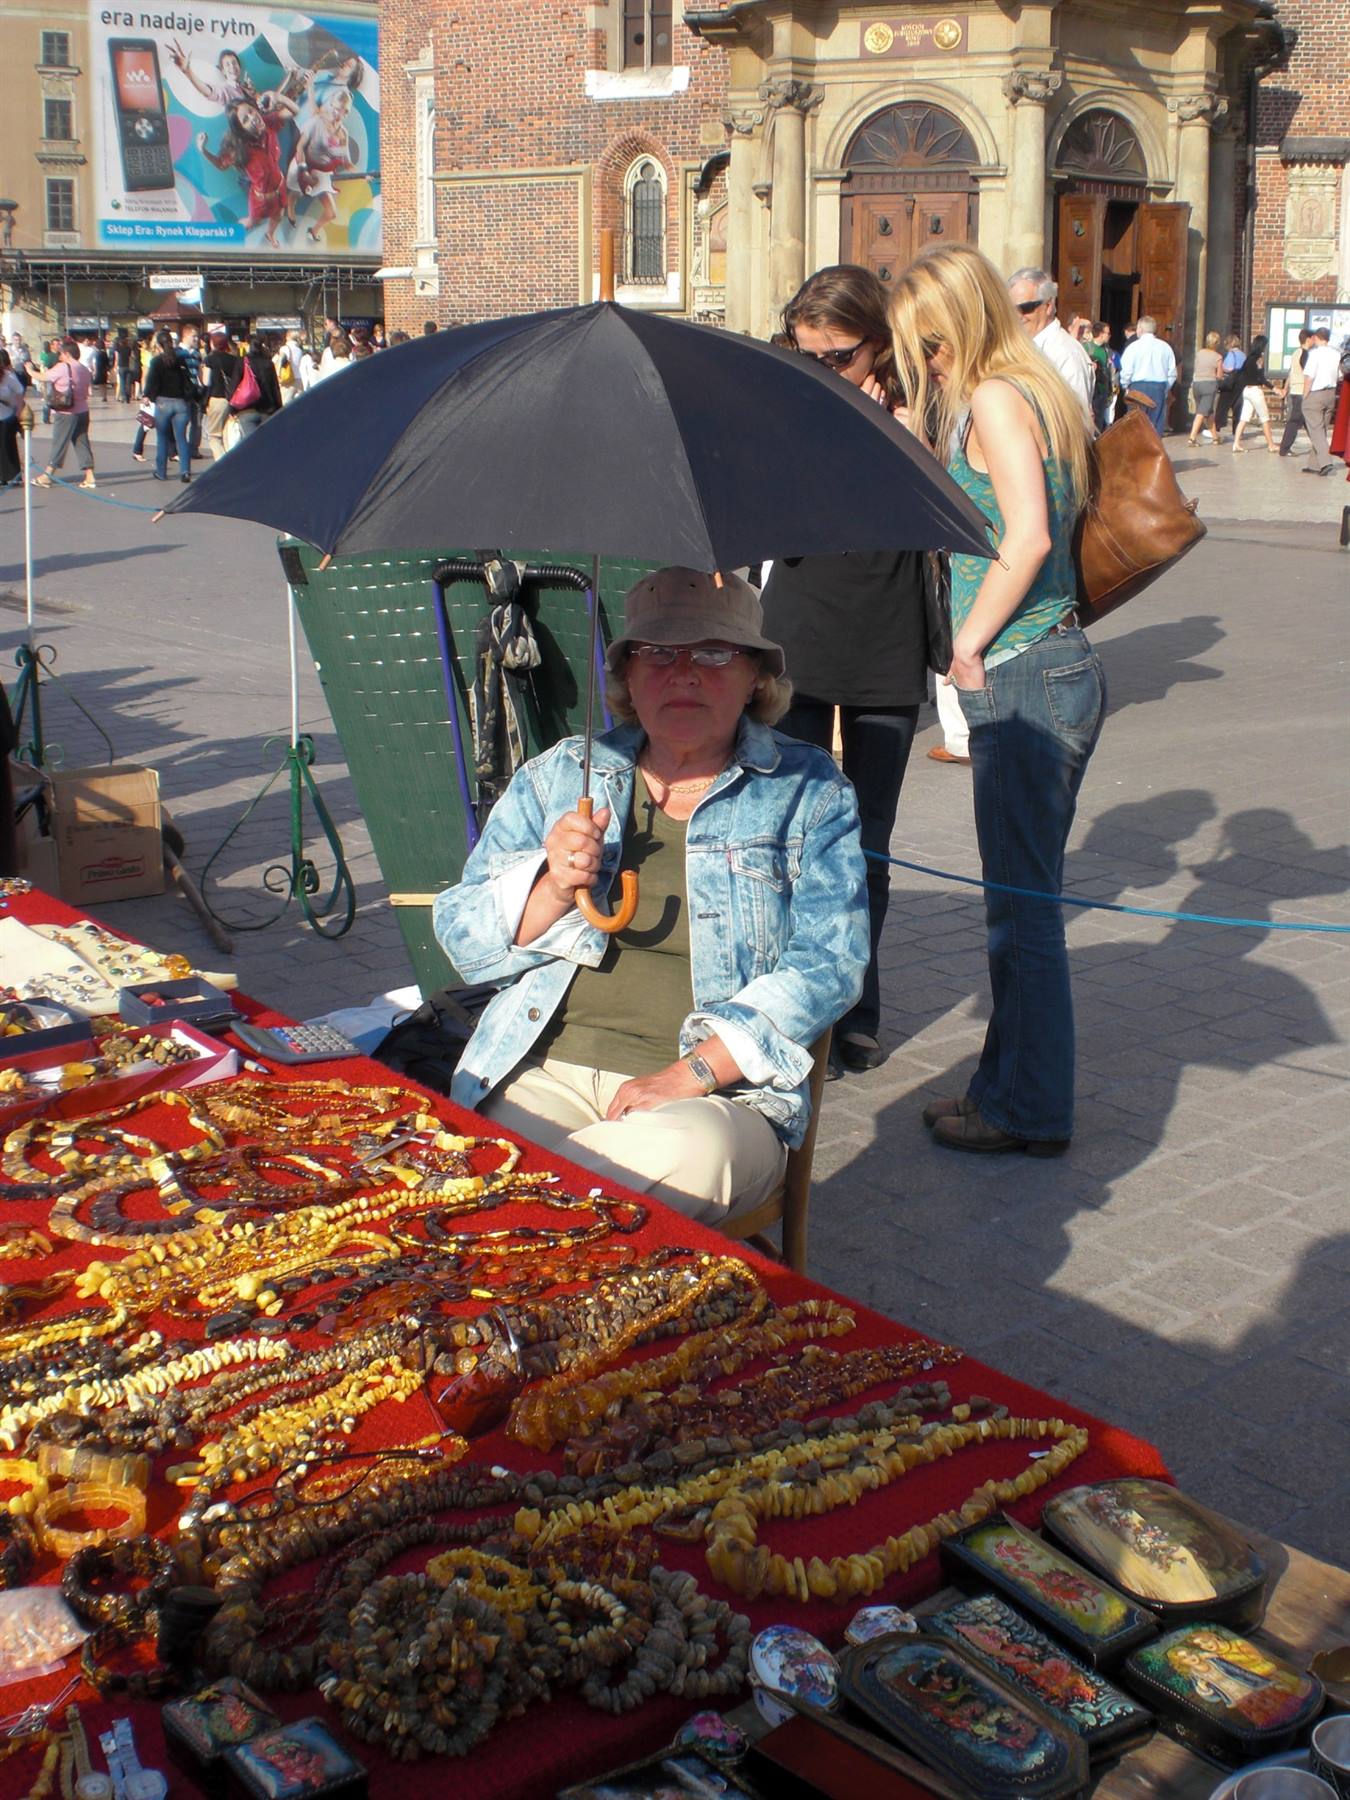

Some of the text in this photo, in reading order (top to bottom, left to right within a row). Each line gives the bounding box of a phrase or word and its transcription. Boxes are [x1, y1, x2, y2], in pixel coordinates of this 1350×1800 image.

[100, 10, 256, 38] era nadaje rytm
[106, 223, 134, 236] Sklep
[134, 224, 155, 236] Era:
[156, 225, 185, 238] Rynek
[228, 227, 235, 237] 9
